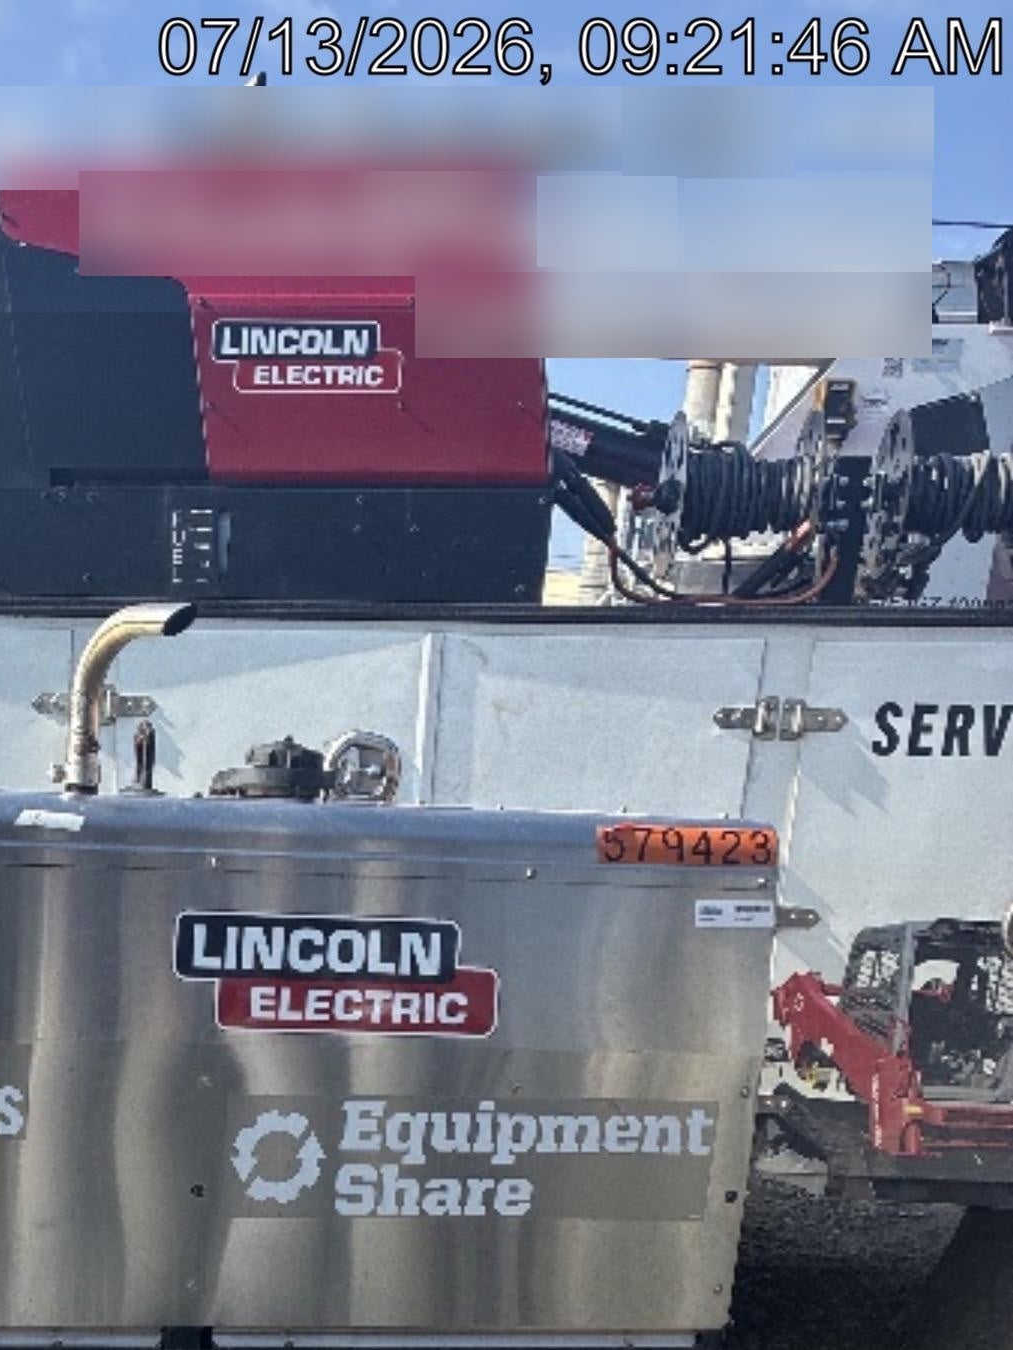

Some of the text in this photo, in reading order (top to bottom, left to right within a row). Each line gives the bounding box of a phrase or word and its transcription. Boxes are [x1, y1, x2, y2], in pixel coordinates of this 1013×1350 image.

[221, 327, 369, 356] LINCOLN
[253, 365, 384, 387] ELECTRIC
[871, 701, 1013, 757] SERV
[604, 827, 772, 864] 579423
[192, 923, 441, 976] LINCOLN
[250, 986, 469, 1024] ELECTRIC
[338, 1100, 715, 1165] Equipment
[334, 1163, 534, 1217] Share
